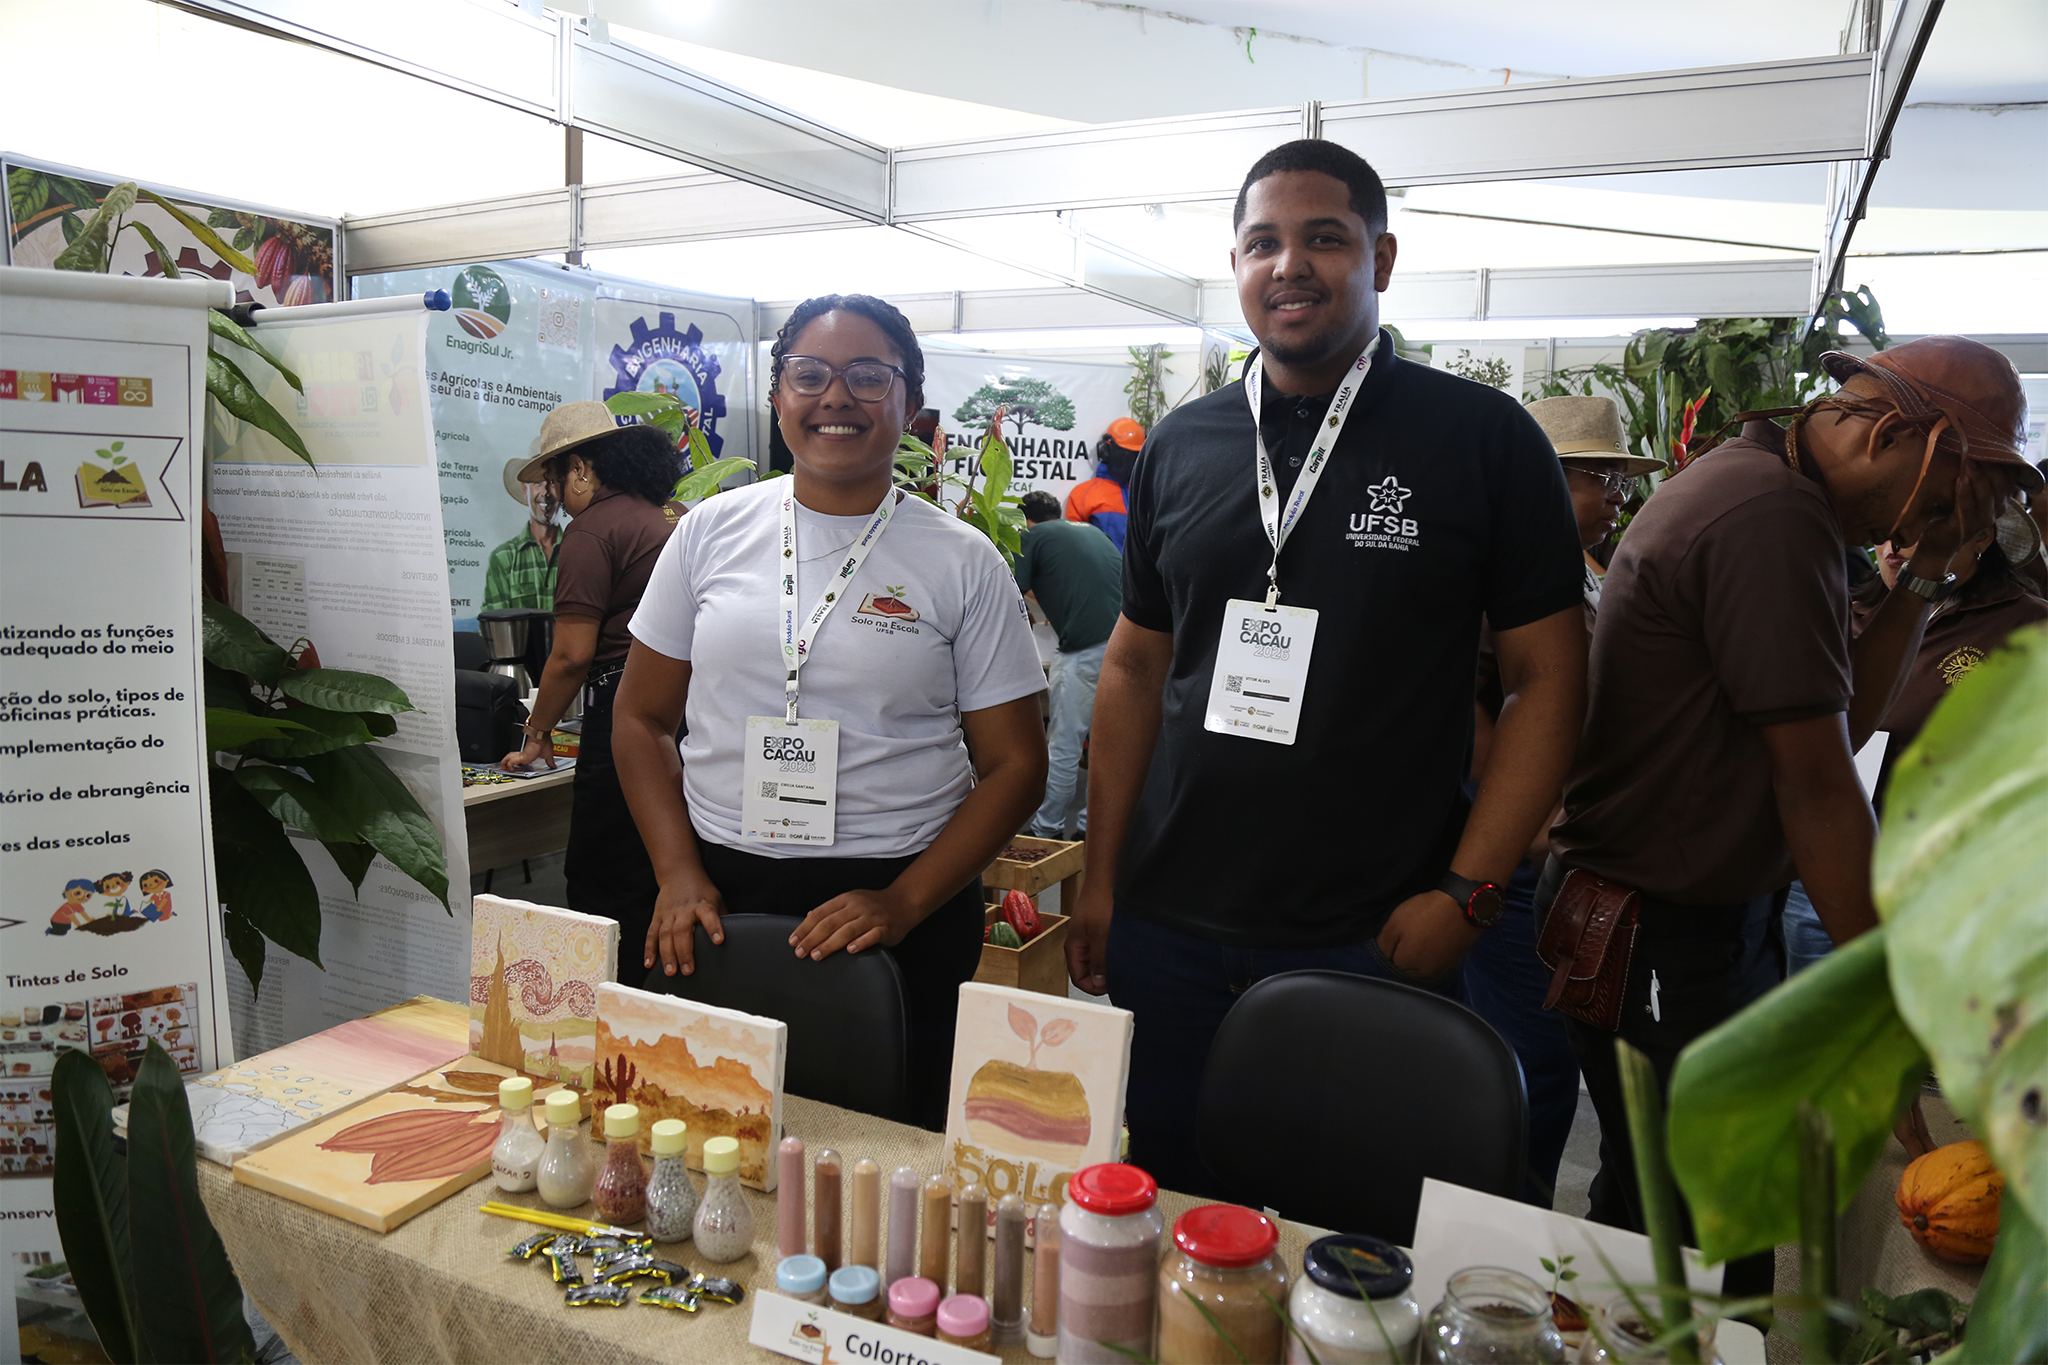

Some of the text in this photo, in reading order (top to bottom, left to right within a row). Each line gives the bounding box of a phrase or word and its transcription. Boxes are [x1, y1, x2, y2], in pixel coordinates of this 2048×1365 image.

[446, 335, 514, 359] EnagriSul Jr.
[440, 371, 494, 391] Agrícolas
[496, 384, 503, 392] e
[505, 383, 562, 403] Ambientais
[430, 384, 555, 413] seu dia a dia no campo!
[435, 430, 470, 441] Agrícola
[945, 433, 1089, 460] ENNHARIA
[454, 462, 479, 472] Terras
[955, 456, 1077, 480] FLESTAL
[1309, 447, 1326, 474] Cargill
[1350, 513, 1419, 537] UFSB
[449, 538, 486, 548] Precisão.
[1346, 533, 1420, 547] UNIVERSIDADE FEDERAL
[1354, 540, 1364, 548] DO
[1388, 543, 1410, 552] BAHIA
[785, 574, 794, 596] Cargill
[0, 624, 174, 642] tizando as funções
[850, 616, 920, 635] Solo na Escola
[876, 627, 894, 635] UFSB
[1, 640, 174, 659] adequado do meio
[1240, 631, 1291, 649] CACAU
[1253, 645, 1290, 661] 2026
[38, 690, 62, 704] do
[68, 689, 111, 704] solo,
[116, 688, 159, 704] tipos
[164, 687, 185, 701] de
[0, 704, 156, 723] oficinas práticas.
[141, 734, 164, 748] do
[763, 748, 815, 762] CACAU
[780, 760, 816, 774] 2026
[49, 787, 72, 800] de
[77, 781, 190, 799] abrangência
[27, 836, 60, 851] das
[66, 831, 130, 848] escolas
[6, 964, 128, 988] Tintas de Solo
